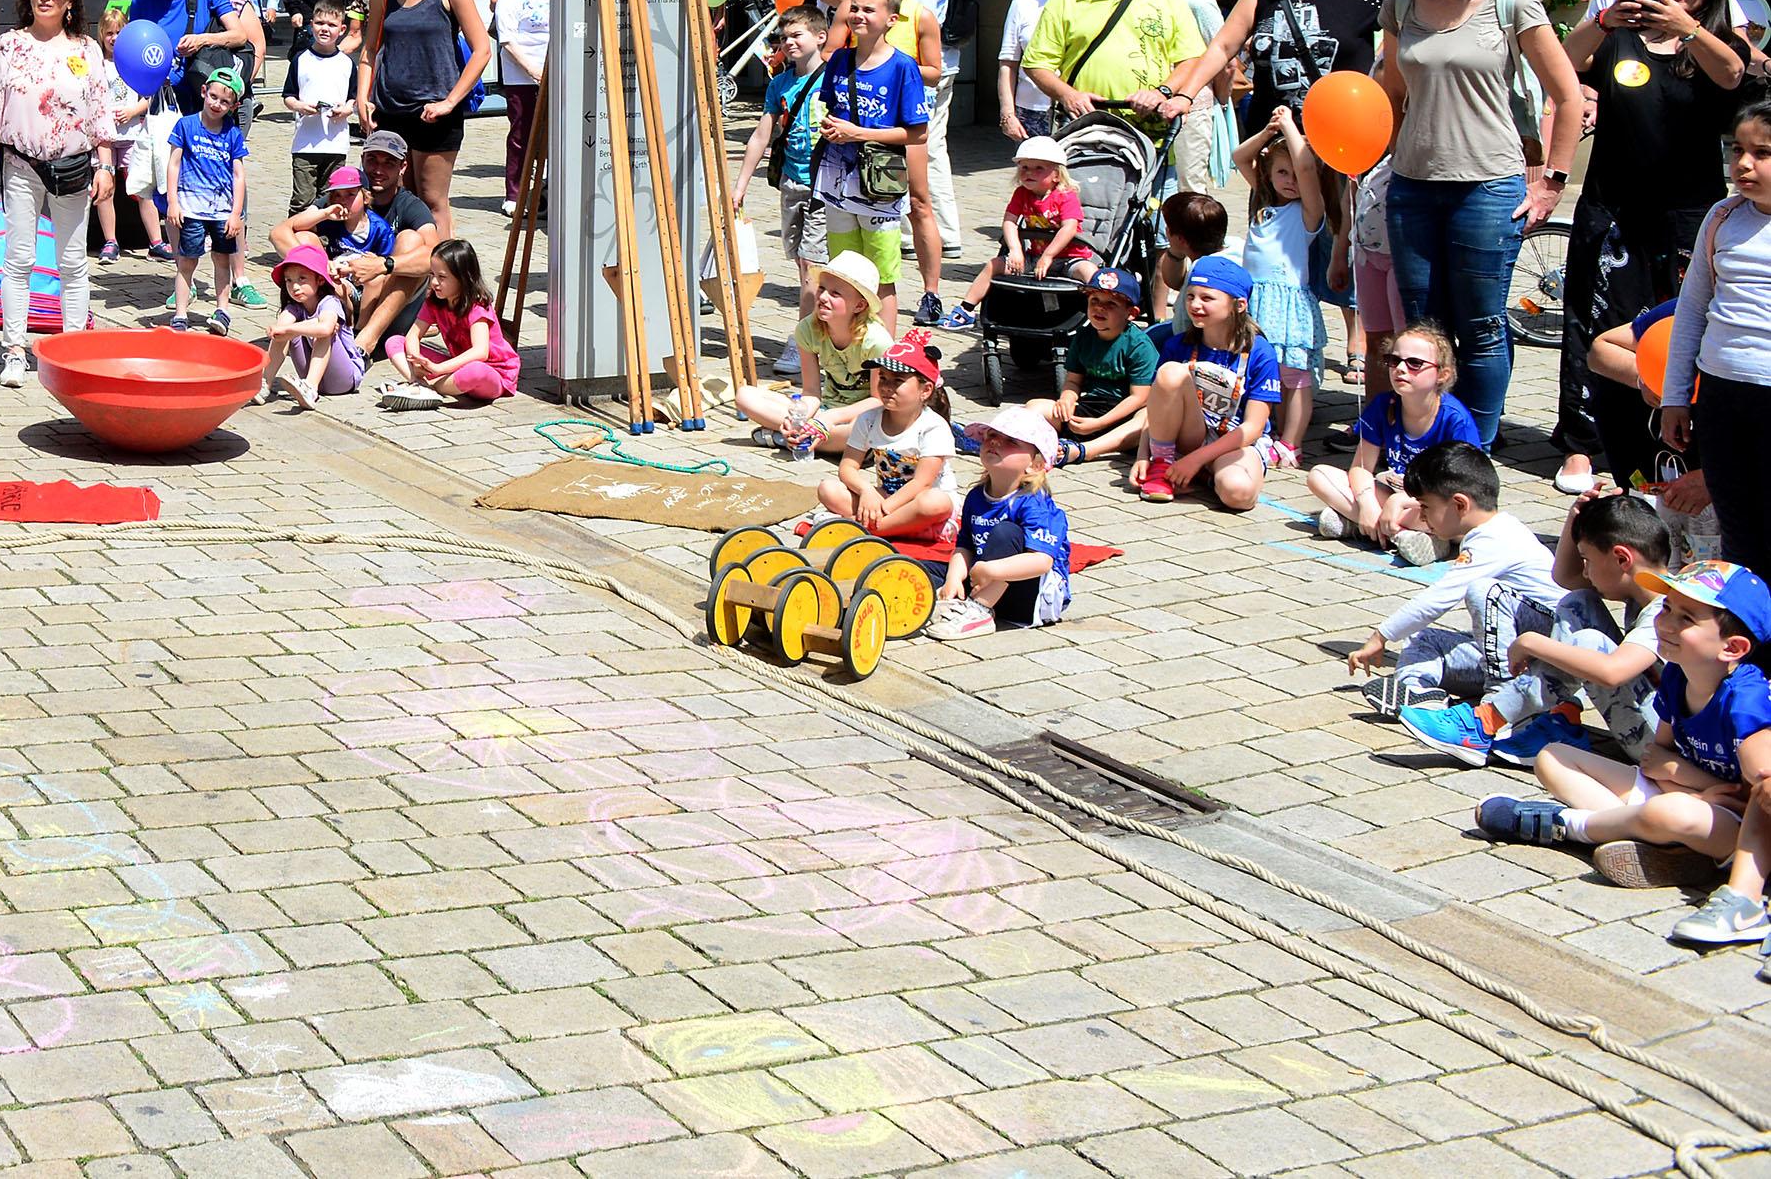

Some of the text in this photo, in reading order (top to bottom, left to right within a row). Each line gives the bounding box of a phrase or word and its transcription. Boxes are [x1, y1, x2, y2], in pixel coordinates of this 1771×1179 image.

[1203, 393, 1232, 418] 42
[898, 568, 927, 616] pedalo
[854, 603, 874, 650] pedalo
